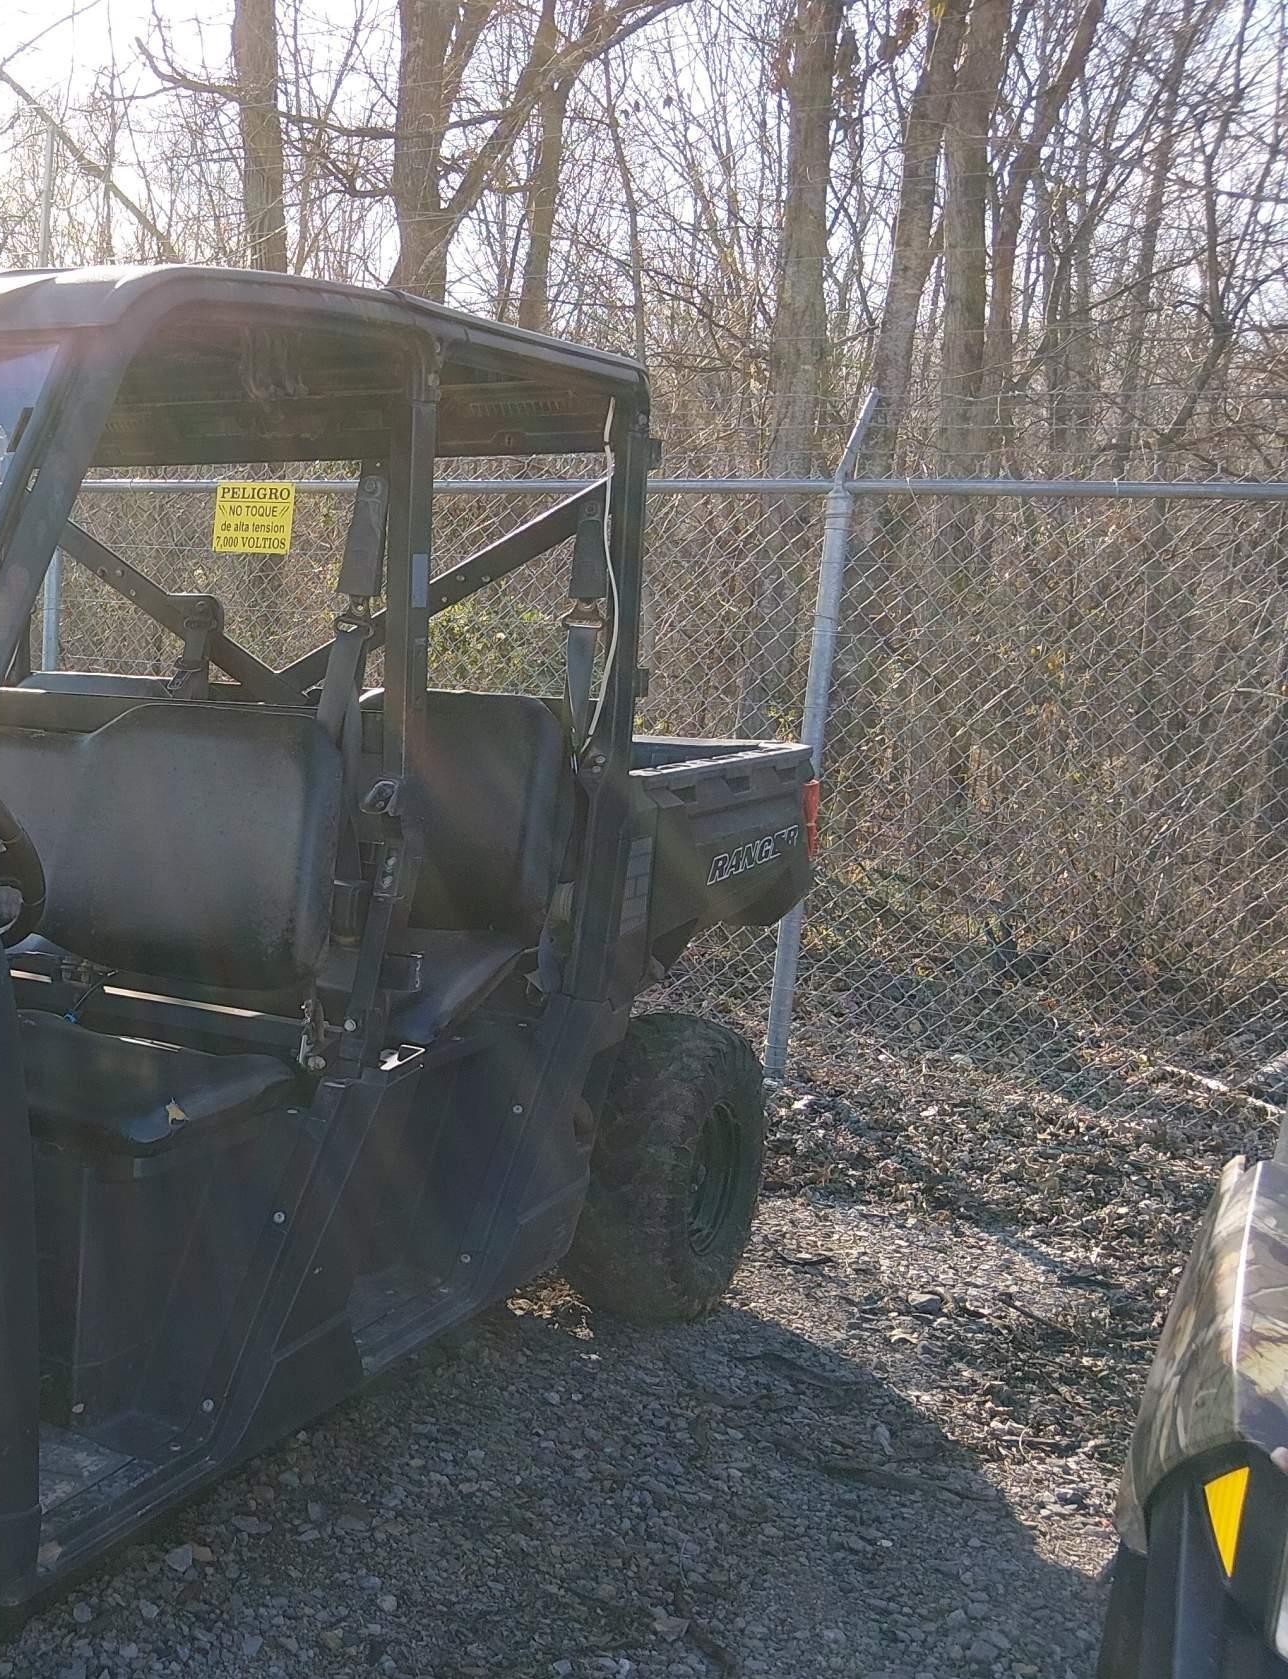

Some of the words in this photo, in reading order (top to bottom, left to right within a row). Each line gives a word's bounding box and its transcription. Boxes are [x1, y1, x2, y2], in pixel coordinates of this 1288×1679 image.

[220, 487, 291, 501] PELIGRO
[228, 504, 243, 517] NO
[245, 505, 279, 518] TOQUE
[220, 520, 232, 532] de
[233, 521, 250, 533] alta
[252, 522, 285, 534] tension
[216, 536, 239, 549] 7,000
[241, 537, 286, 550] VOLTIOS
